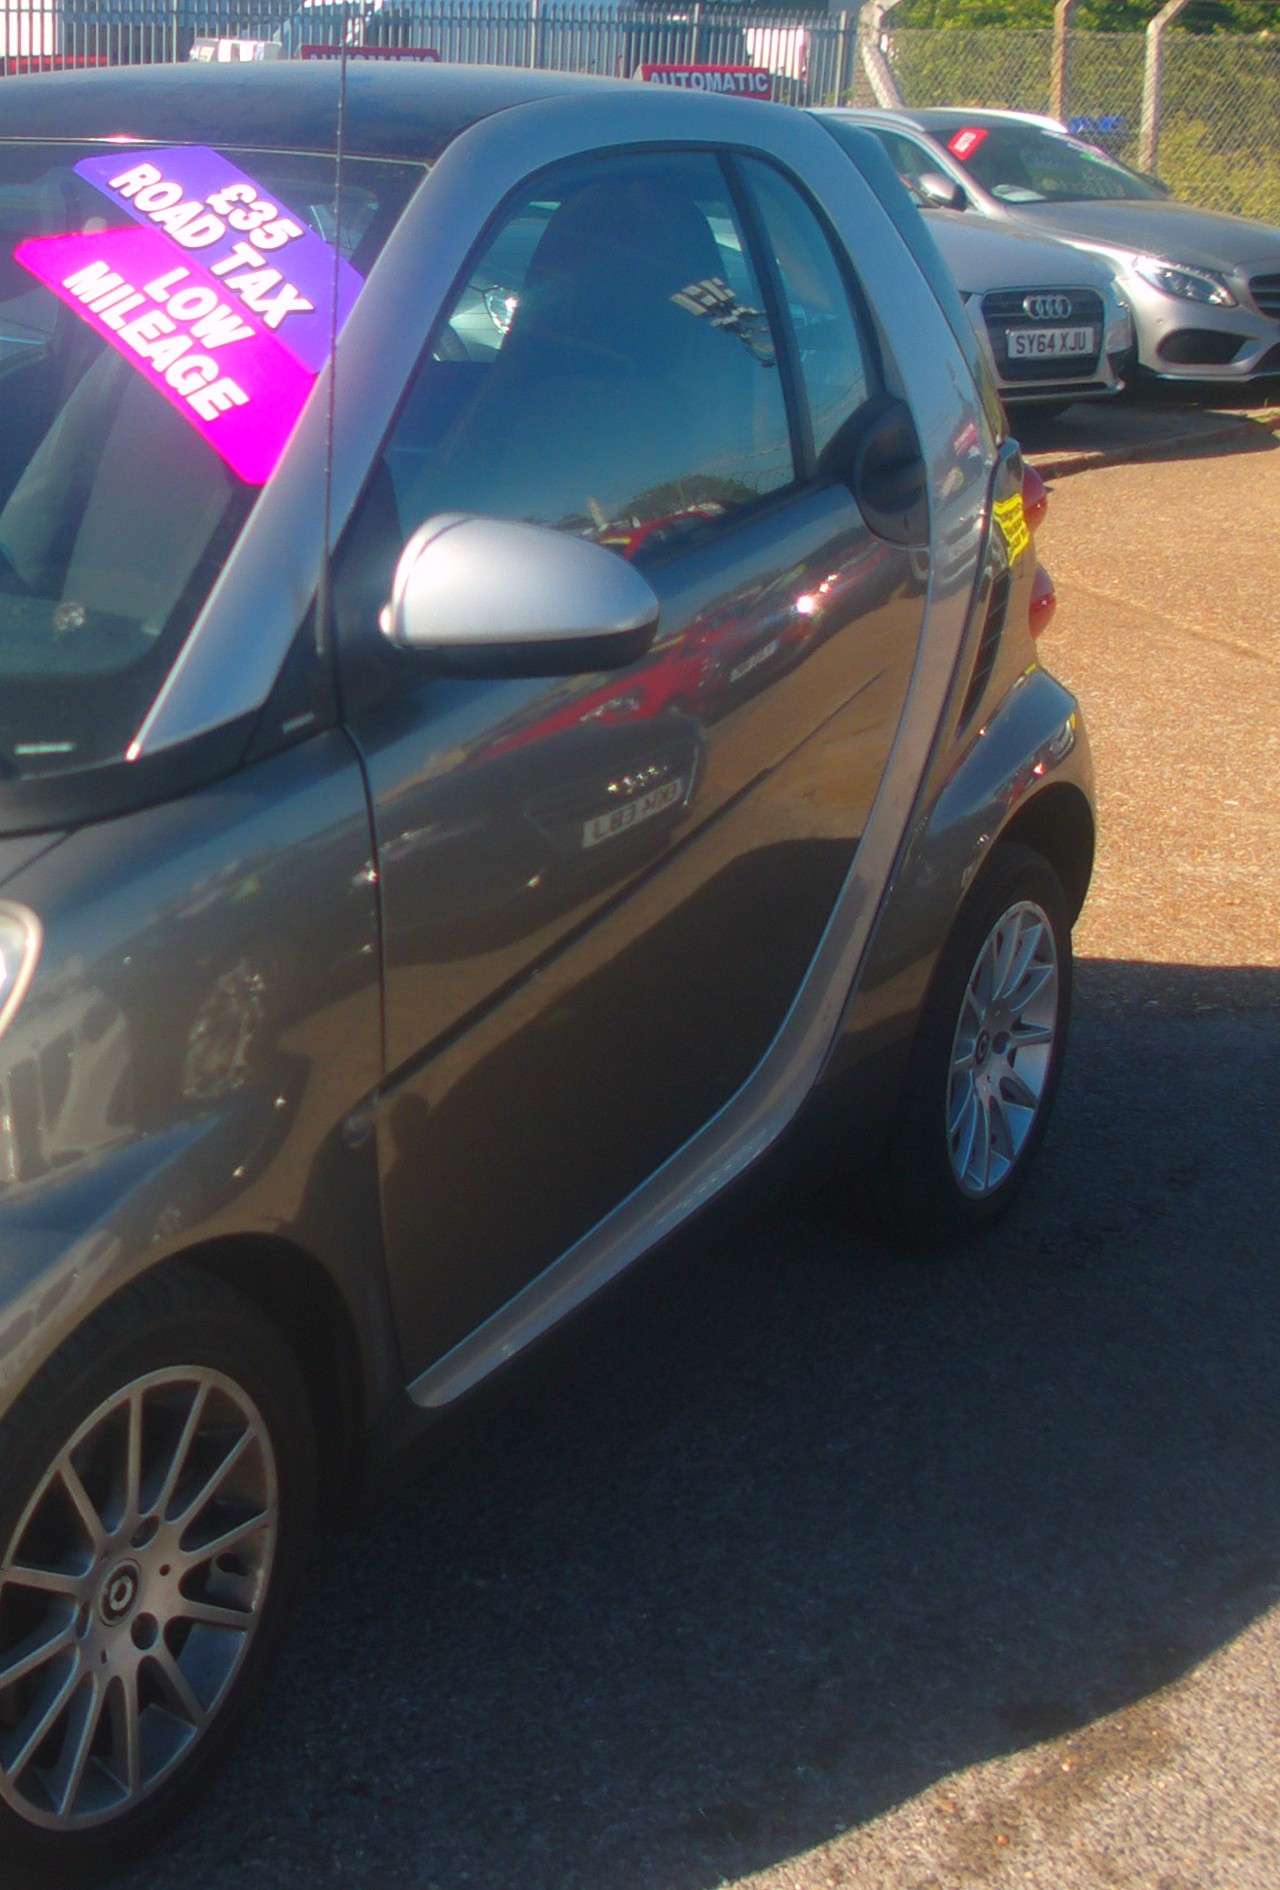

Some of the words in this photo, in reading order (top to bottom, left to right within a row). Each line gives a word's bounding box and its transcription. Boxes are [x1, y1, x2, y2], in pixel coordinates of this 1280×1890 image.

[649, 71, 769, 93] AUTOMATIC
[107, 162, 227, 249] ROAD
[209, 240, 316, 330] TAX
[205, 183, 306, 250] £35
[61, 260, 251, 423] MILEAGE
[142, 265, 257, 350] LOW
[1015, 334, 1056, 355] SY64
[1060, 331, 1088, 352] XJU
